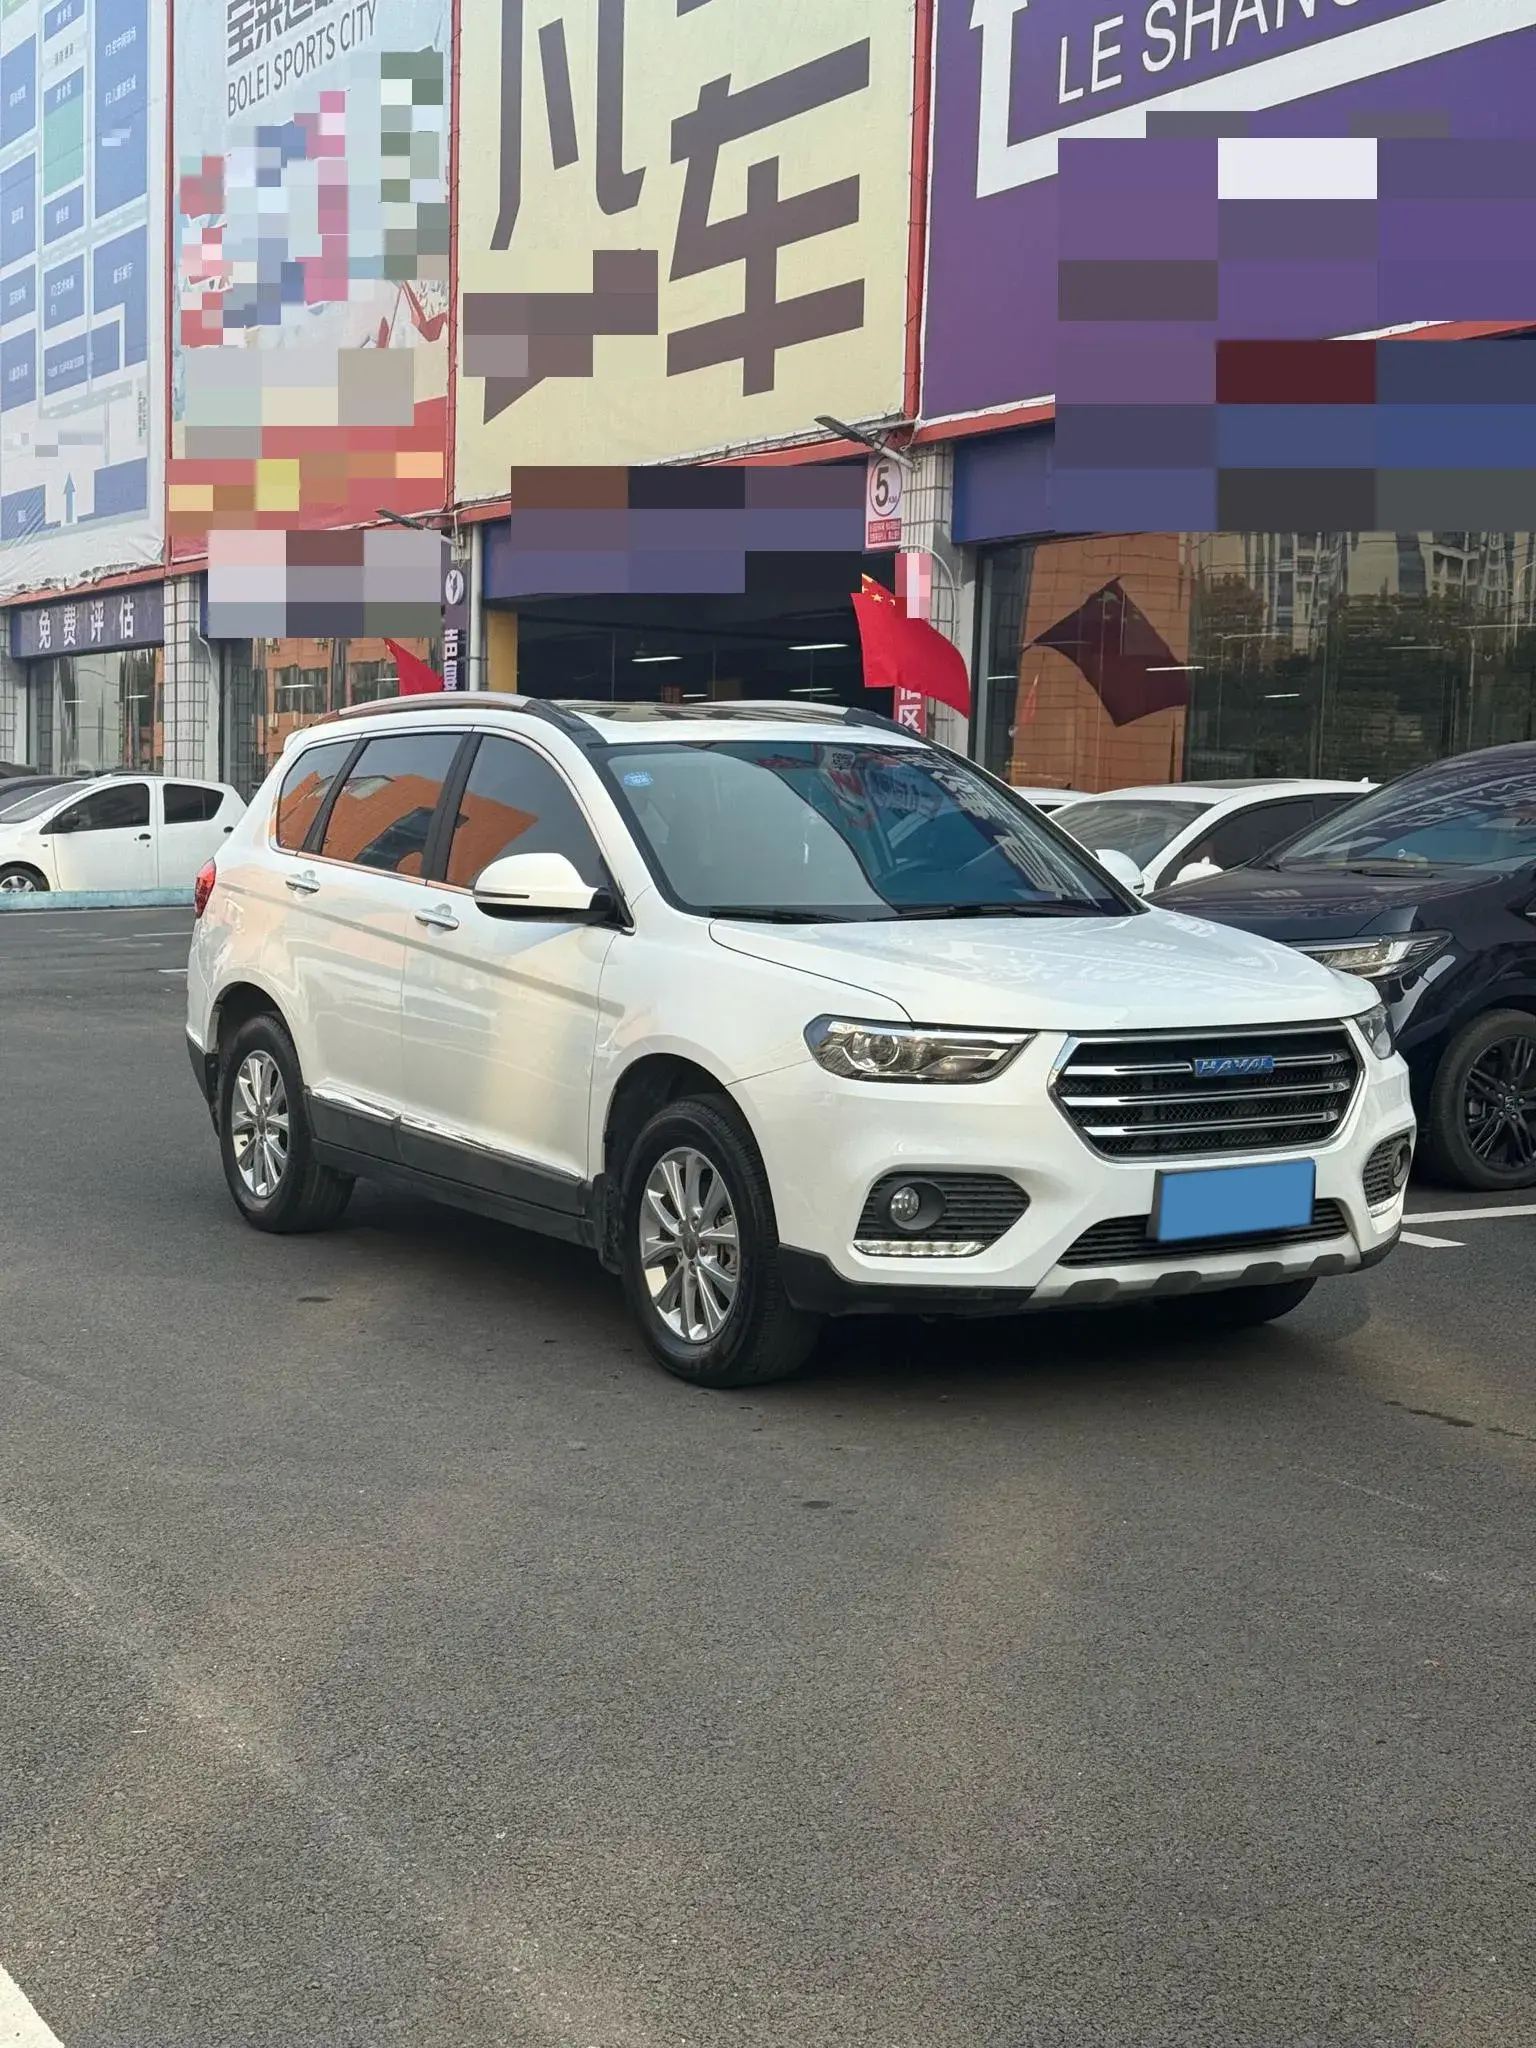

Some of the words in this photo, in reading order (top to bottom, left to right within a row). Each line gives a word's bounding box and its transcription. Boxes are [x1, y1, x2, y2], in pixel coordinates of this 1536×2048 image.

[228, 61, 270, 118] BOLEI
[273, 22, 335, 91] SPORTS
[340, 0, 377, 51] CITY
[1059, 15, 1124, 104] LE
[875, 466, 889, 507] 5
[39, 595, 134, 649] 免费评估
